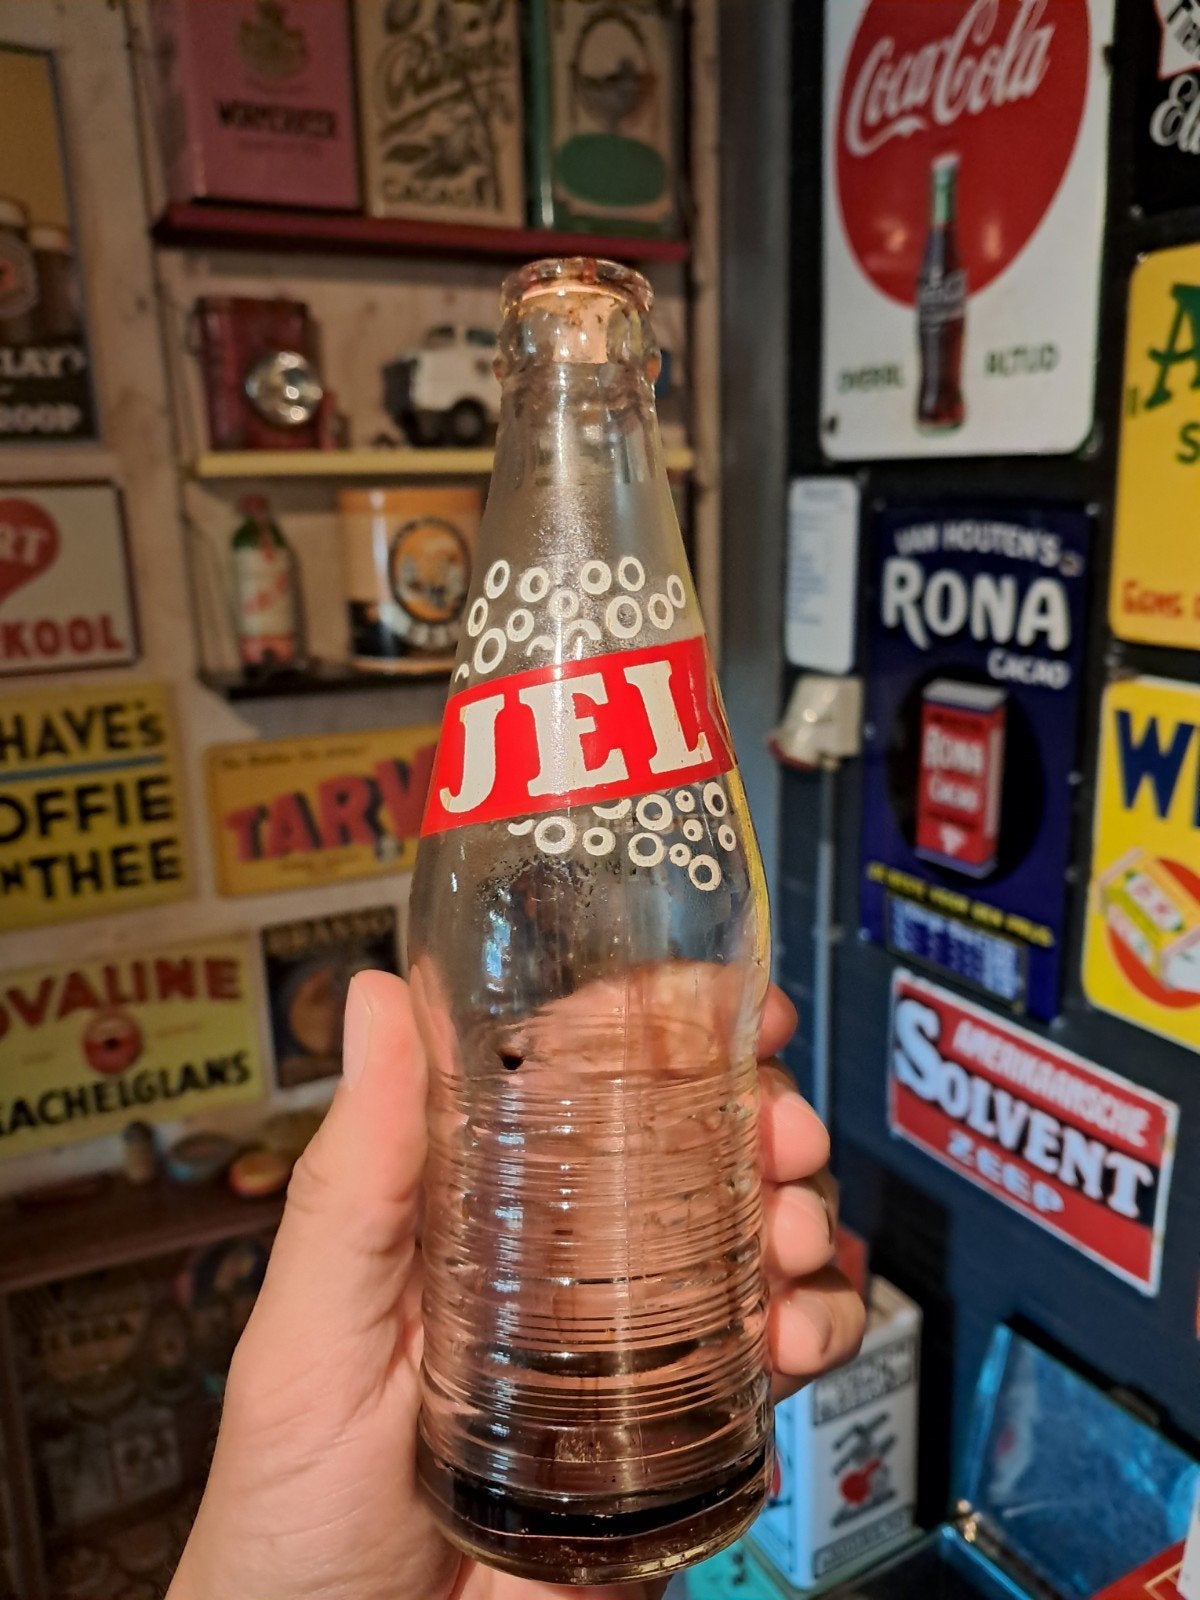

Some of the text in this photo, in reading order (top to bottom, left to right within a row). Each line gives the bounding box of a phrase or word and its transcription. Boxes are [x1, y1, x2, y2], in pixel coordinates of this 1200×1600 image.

[2, 614, 125, 658] KOOL
[881, 554, 1070, 652] RONA
[439, 660, 713, 813] JEL
[29, 838, 183, 899] THEE
[895, 1000, 1154, 1219] SOLVENT
